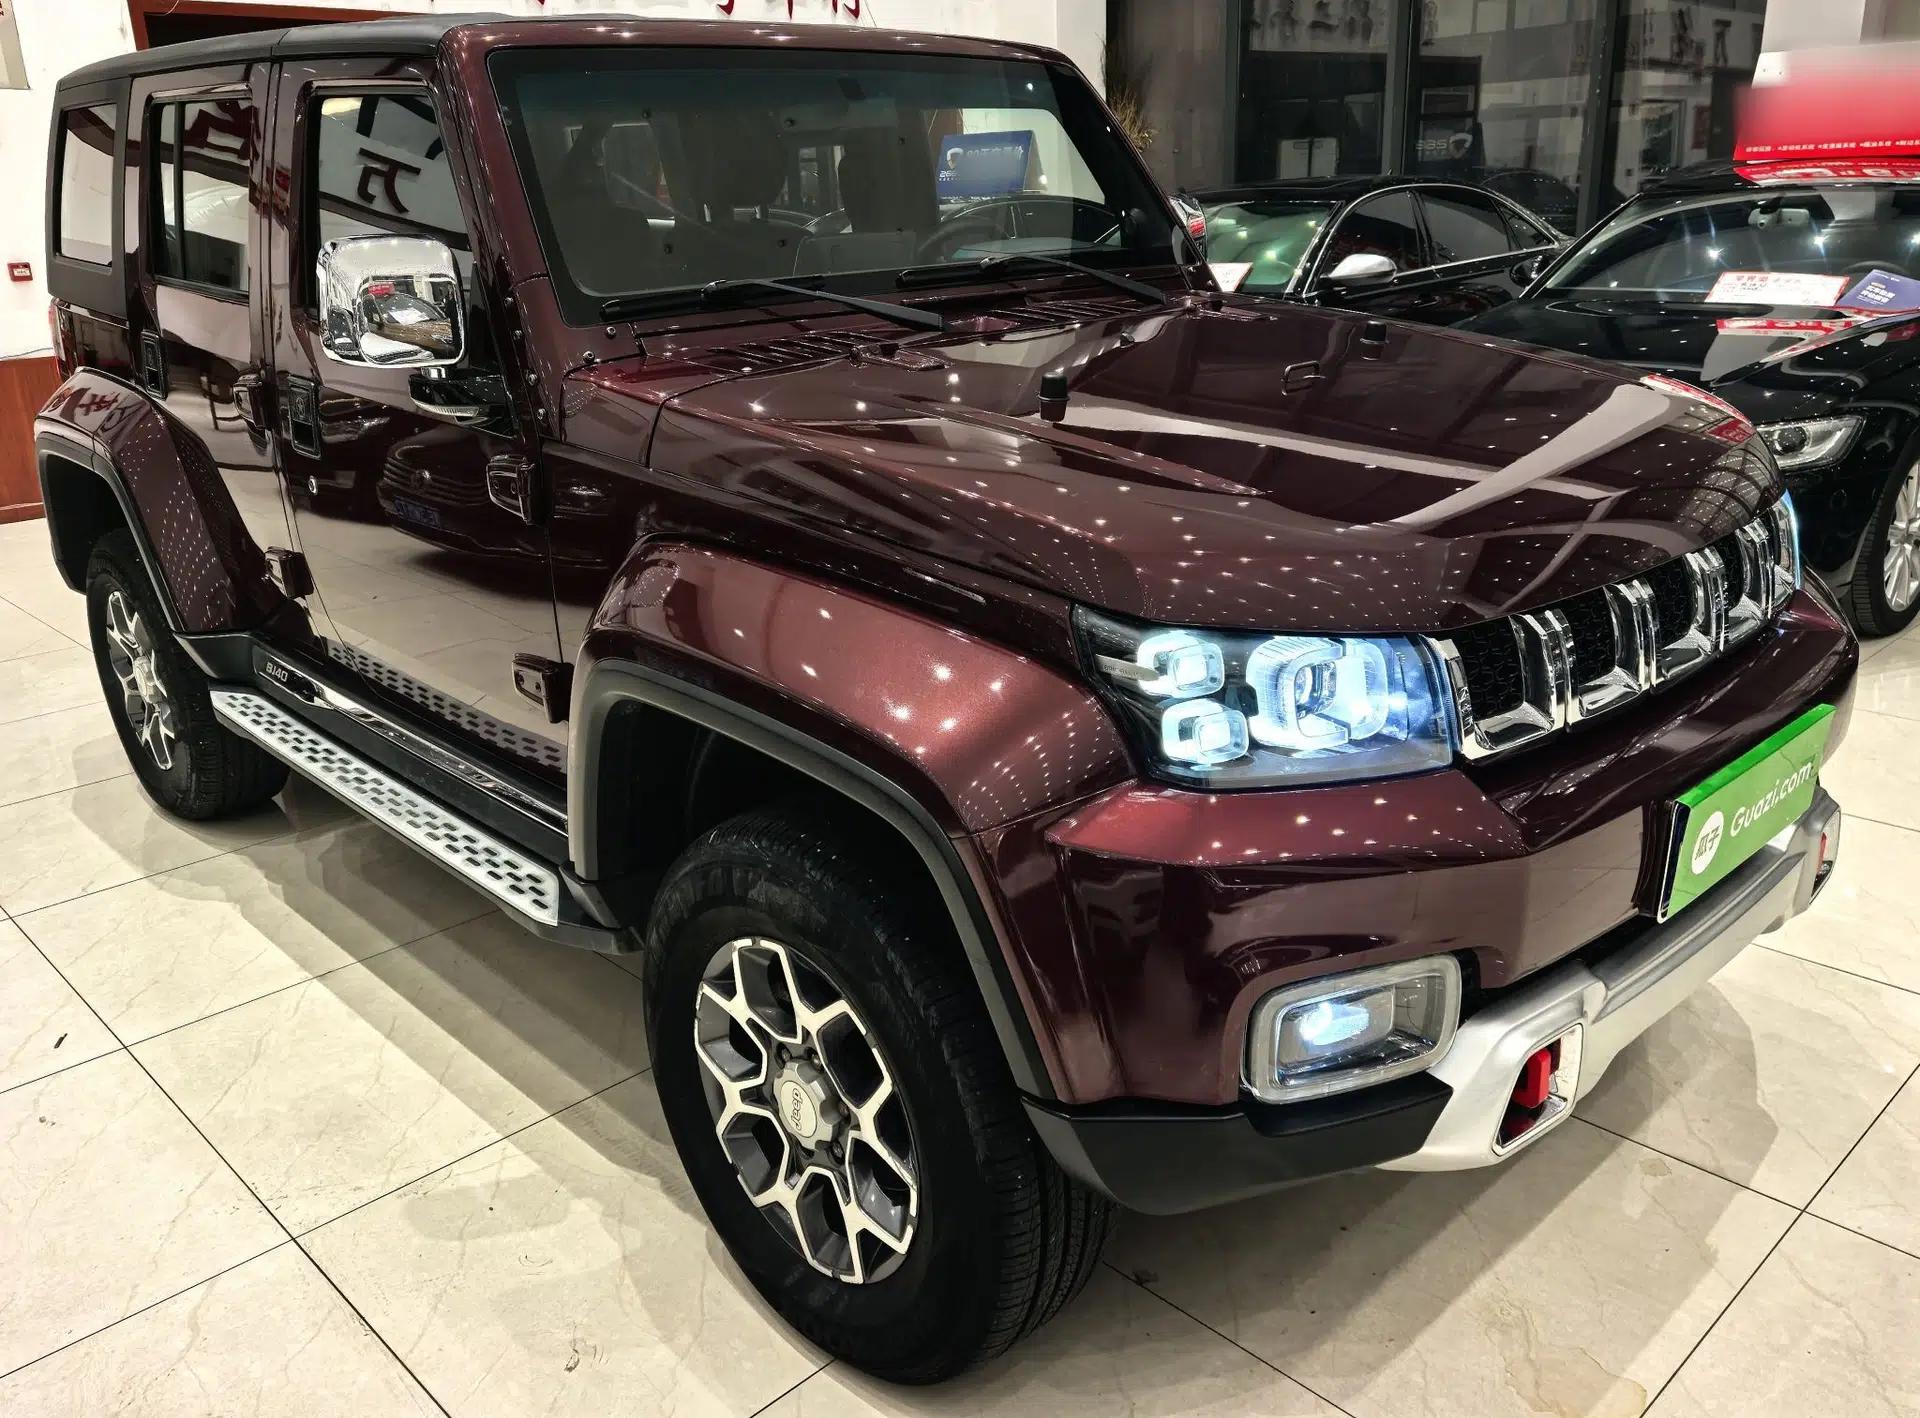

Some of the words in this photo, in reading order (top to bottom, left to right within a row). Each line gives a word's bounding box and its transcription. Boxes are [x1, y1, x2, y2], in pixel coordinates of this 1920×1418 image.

[265, 661, 288, 682] BJ40
[1730, 762, 1812, 837] Guazi.com
[1694, 824, 1720, 861] 瓜子
[790, 1087, 804, 1133] Jeep
